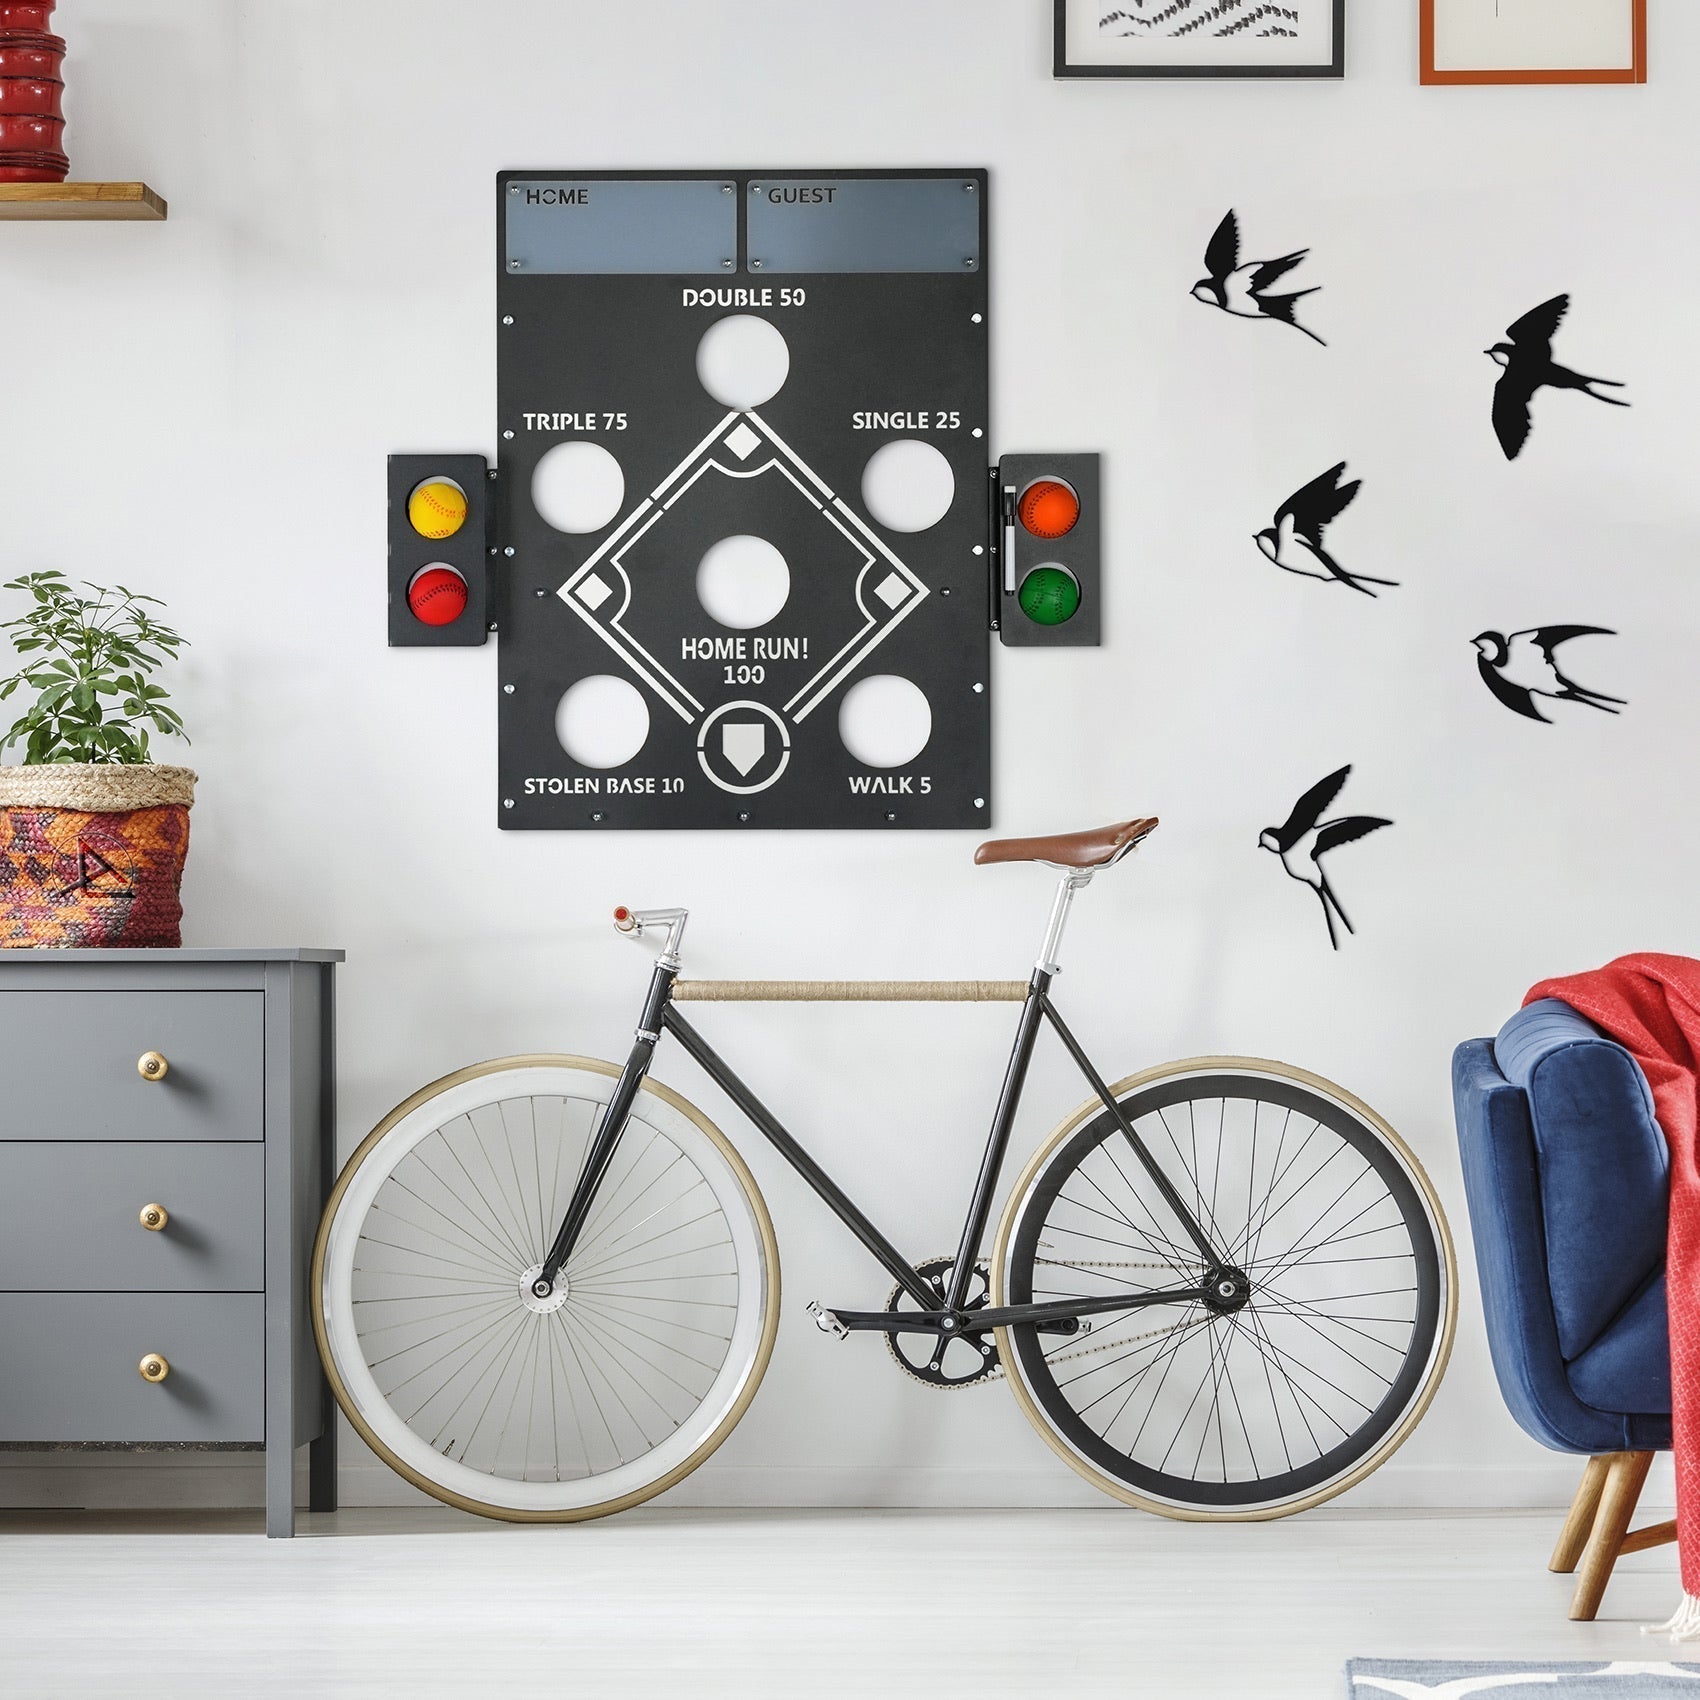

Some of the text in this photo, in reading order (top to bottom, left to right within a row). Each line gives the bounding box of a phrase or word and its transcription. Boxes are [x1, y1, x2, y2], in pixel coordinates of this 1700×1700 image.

[525, 188, 589, 205] HOME
[768, 187, 837, 204] GUEST
[682, 288, 806, 307] DOUBLE 50
[523, 413, 628, 431] TRIPLE 75
[852, 411, 961, 430] SINGLE 25
[681, 637, 809, 660] HOME RUN!
[723, 665, 765, 685] 100
[524, 777, 685, 795] STOLEN BASE 10
[848, 776, 932, 795] WALK 5
